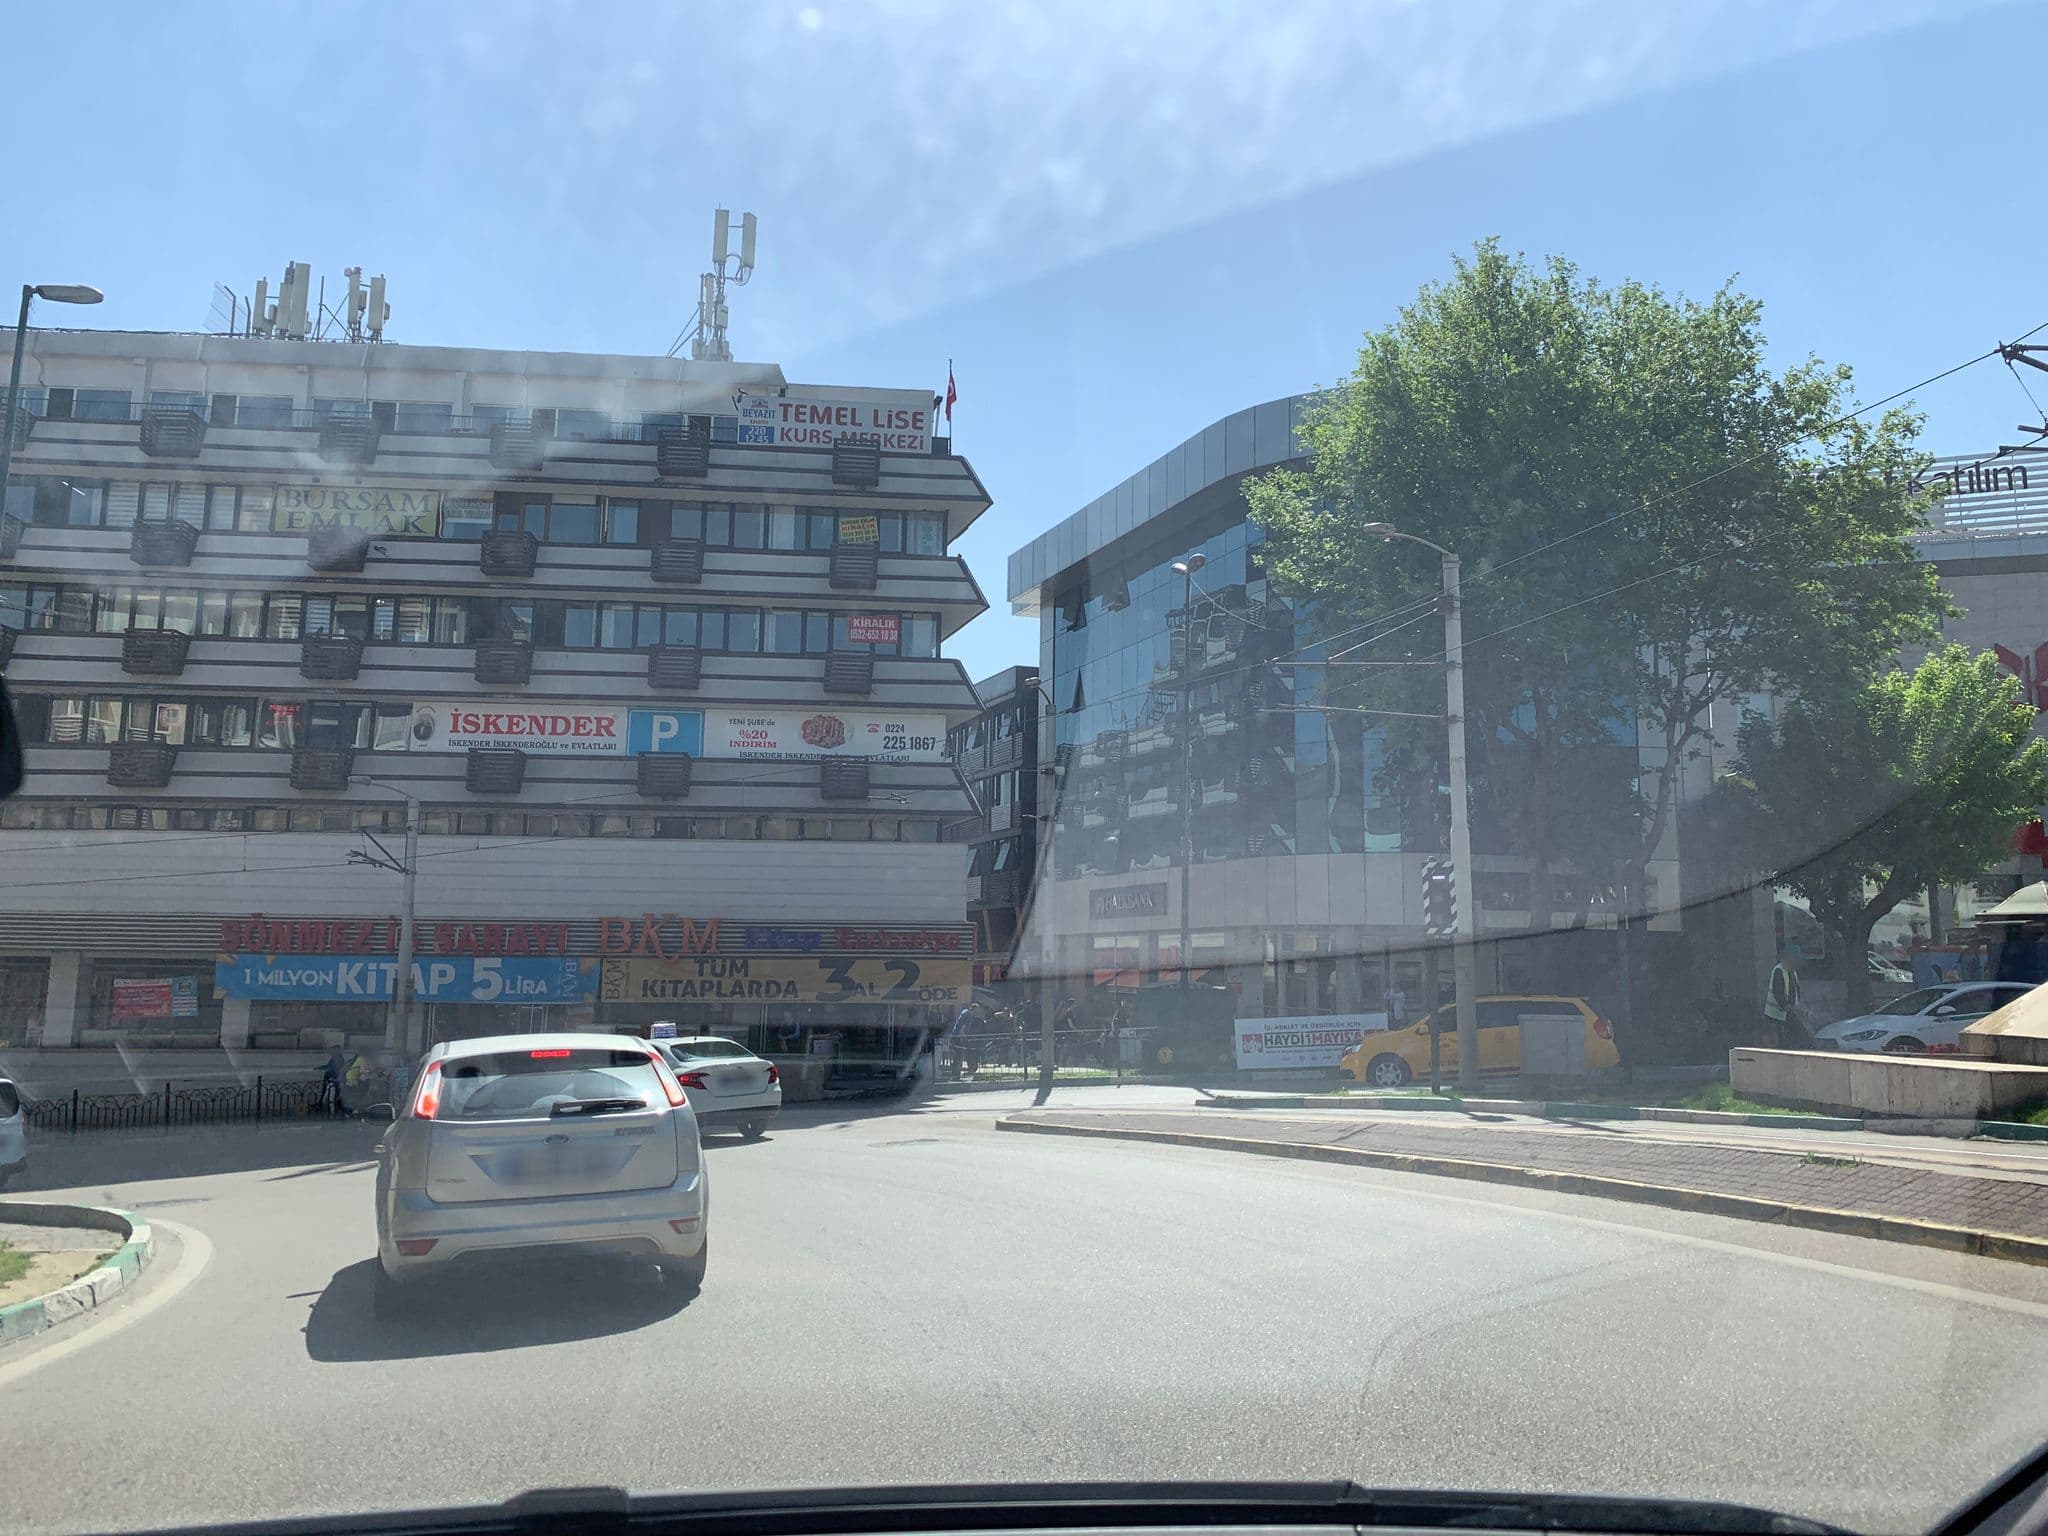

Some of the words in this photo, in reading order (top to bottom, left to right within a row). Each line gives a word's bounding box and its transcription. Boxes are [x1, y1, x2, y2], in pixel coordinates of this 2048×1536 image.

[742, 408, 777, 419] BEYAZIT
[779, 402, 863, 428] TEMEL
[748, 426, 767, 436] 220
[780, 426, 833, 445] KURS
[284, 489, 432, 513] BURSAM
[286, 511, 426, 534] EMLAK
[449, 708, 617, 737] İSKENDER
[651, 714, 679, 753] P
[885, 723, 905, 733] 0224
[448, 738, 491, 748] İSKENDER
[493, 739, 558, 750] İSKENDEROĞLU
[571, 742, 617, 751] EVLATLARI
[739, 729, 768, 740] %20
[883, 735, 907, 750] 225
[909, 736, 936, 751] 1867
[599, 912, 722, 963] BKM
[244, 969, 251, 985] 1
[258, 968, 333, 986] MİLYON
[337, 961, 456, 995] KİTAP
[471, 957, 502, 1001] 5
[604, 960, 625, 1000] BKM
[641, 978, 798, 999] KİTAPLARDA
[815, 958, 856, 1001] 3
[853, 983, 881, 997] AL
[881, 960, 921, 1000] 2
